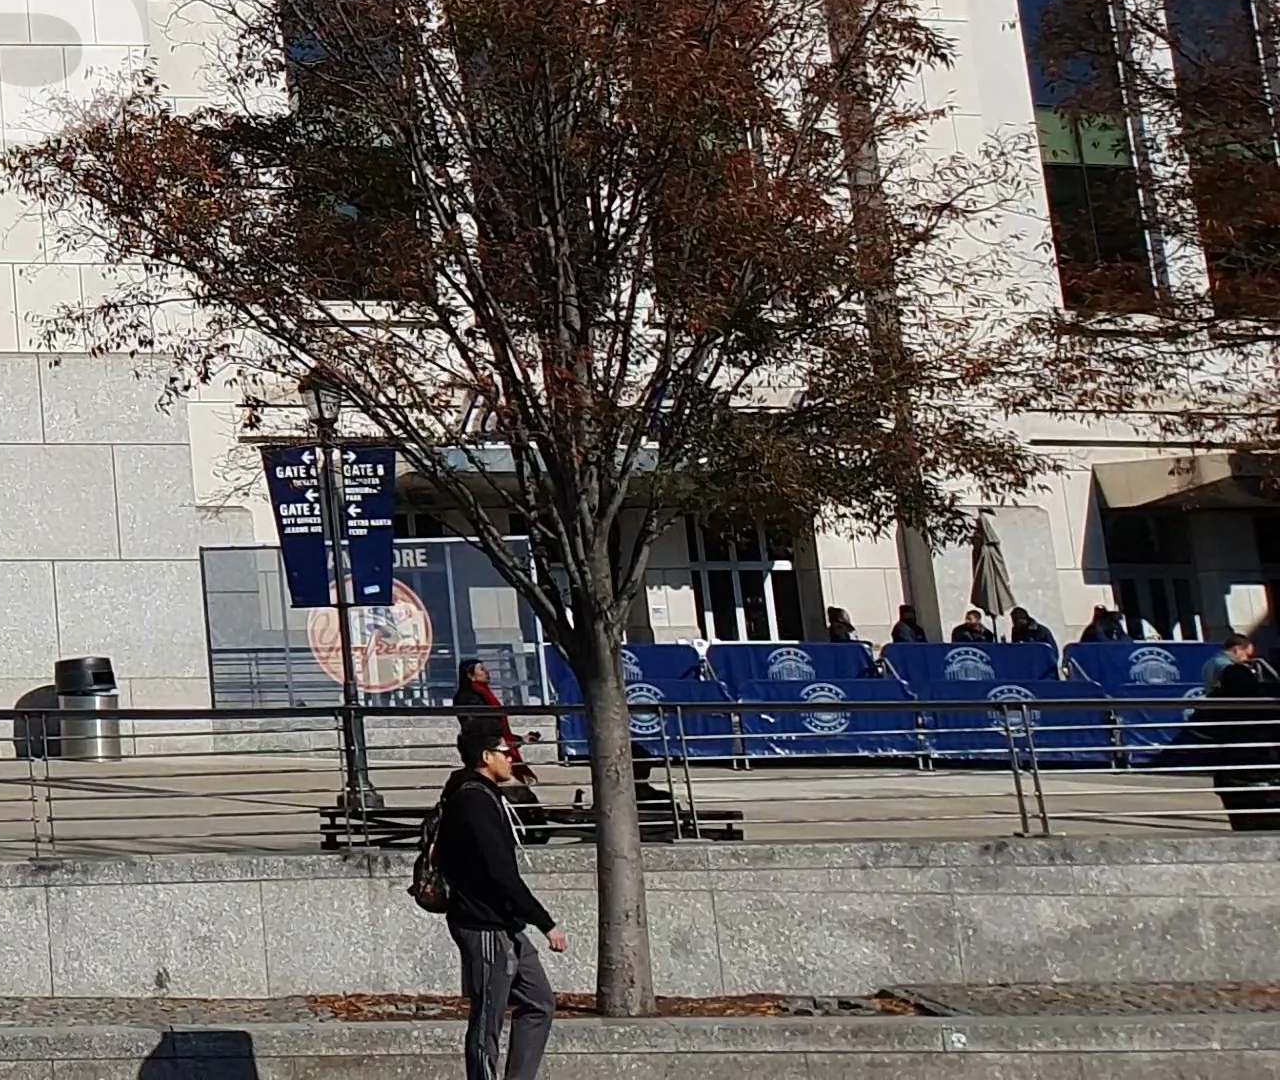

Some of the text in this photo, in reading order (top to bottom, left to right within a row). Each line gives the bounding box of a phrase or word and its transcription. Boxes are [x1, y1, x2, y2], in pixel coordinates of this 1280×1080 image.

[276, 465, 307, 479] GATE
[343, 464, 374, 477] GATE
[280, 503, 321, 516] GATE 2
